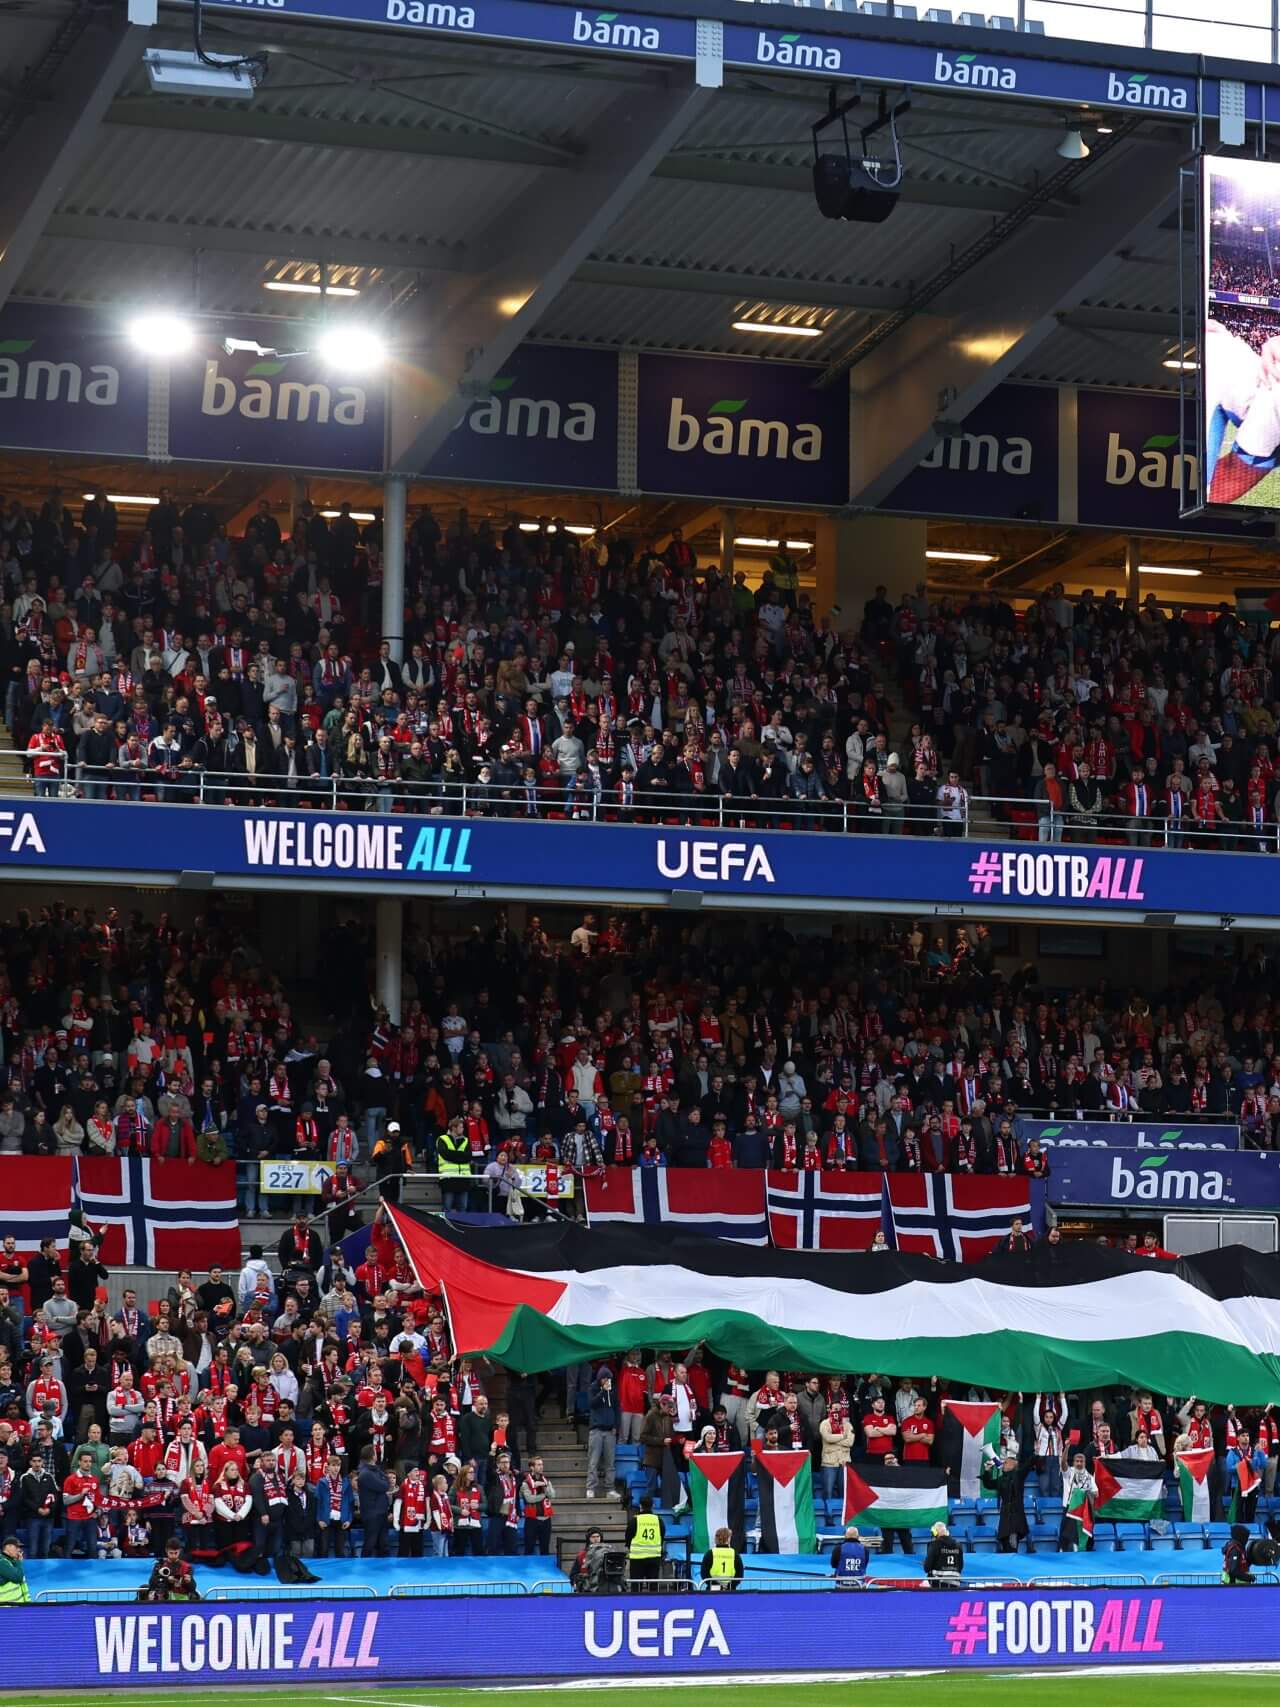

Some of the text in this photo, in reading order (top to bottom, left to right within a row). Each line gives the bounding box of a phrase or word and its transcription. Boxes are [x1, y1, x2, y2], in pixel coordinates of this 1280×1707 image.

[572, 11, 660, 49] bama
[757, 32, 841, 69] bama
[934, 52, 1016, 89] bama
[1107, 72, 1187, 109] bama
[201, 359, 367, 426] bama
[455, 395, 597, 441] ama
[667, 397, 823, 462] bama
[244, 819, 473, 873] WELCOME ALL
[657, 840, 776, 883] UEFA
[968, 851, 1145, 901] #FOOTBALL
[269, 1171, 304, 1189] 227
[1111, 1157, 1224, 1200] bama
[641, 1528, 656, 1541] 43
[721, 1561, 727, 1574] 1
[946, 1556, 955, 1565] 12
[95, 1611, 380, 1673] WELCOME ALL
[584, 1608, 731, 1657] UEFA
[945, 1599, 1165, 1655] #FOOTBALL
